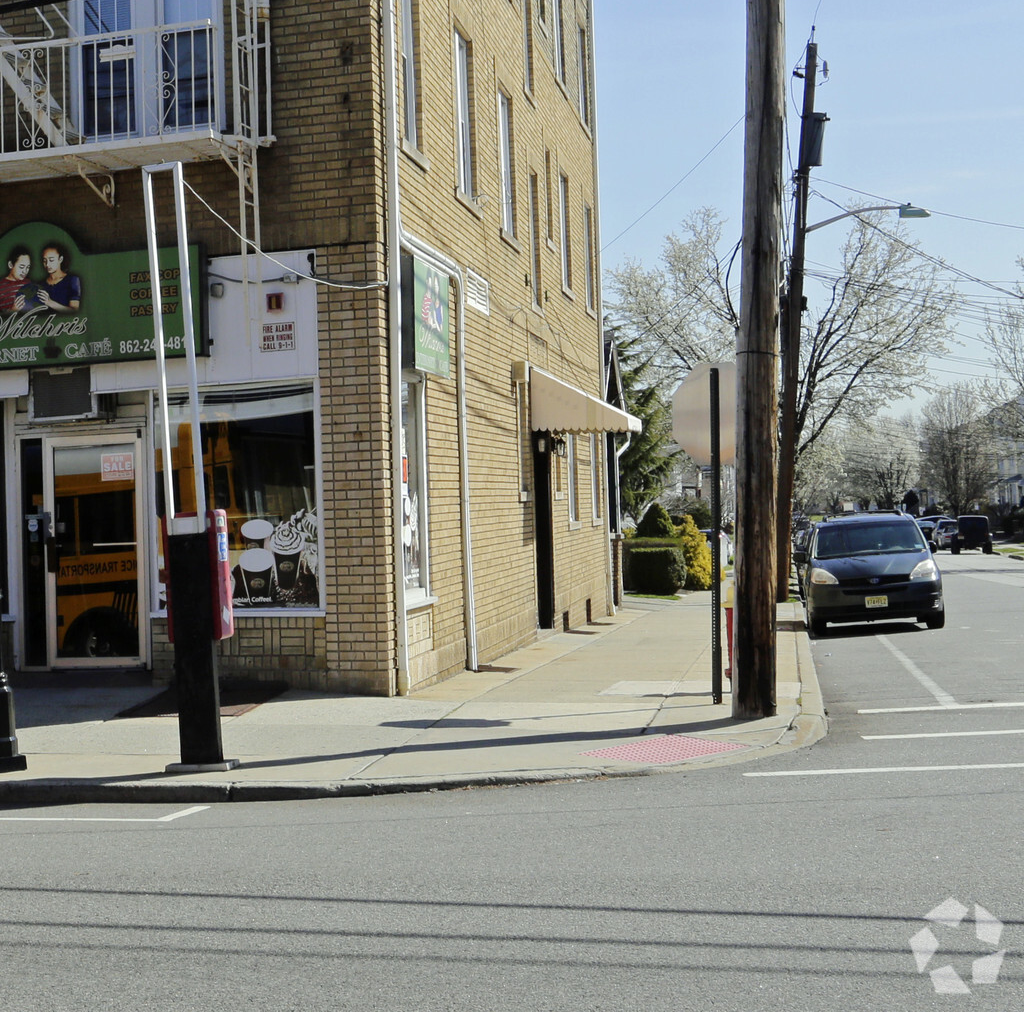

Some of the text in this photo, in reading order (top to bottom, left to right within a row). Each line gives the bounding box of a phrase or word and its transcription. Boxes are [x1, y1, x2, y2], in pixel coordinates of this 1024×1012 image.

[130, 272, 151, 283] FAX
[130, 285, 177, 300] COEE
[130, 303, 178, 317] PASRY
[262, 324, 293, 334] FIRE ALARM
[64, 337, 112, 359] CAFÉ
[103, 462, 132, 472] SALE
